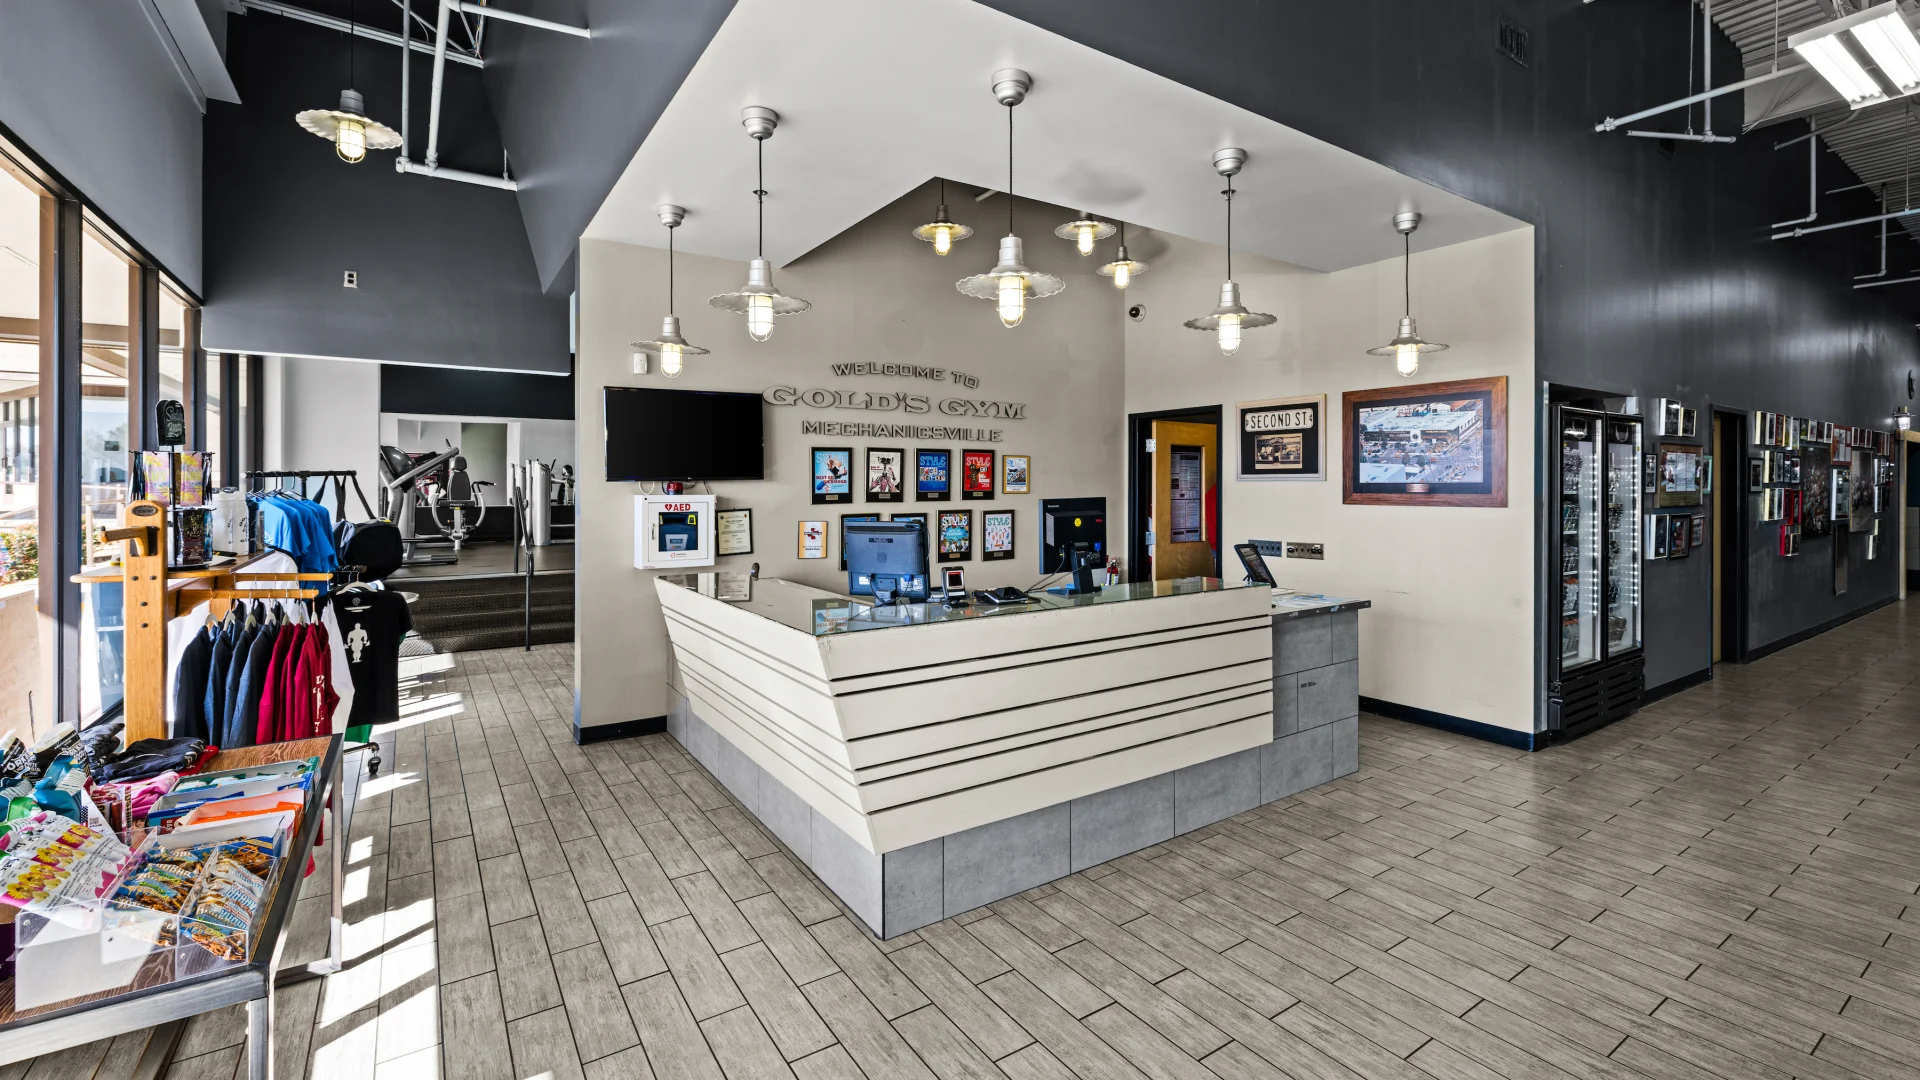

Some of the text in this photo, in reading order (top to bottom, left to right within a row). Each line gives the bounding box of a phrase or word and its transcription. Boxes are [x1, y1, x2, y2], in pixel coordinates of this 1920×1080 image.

[832, 361, 979, 389] WELCOME TO
[762, 385, 1027, 420] GOLD'S GYM
[1250, 412, 1307, 429] SECOND ST.
[802, 420, 1003, 443] MECHANICSVILLE
[920, 455, 946, 466] STYLE
[966, 456, 991, 467] STYLE
[673, 503, 691, 512] AED
[941, 516, 968, 526] STYLE
[987, 516, 1010, 526] STYLE
